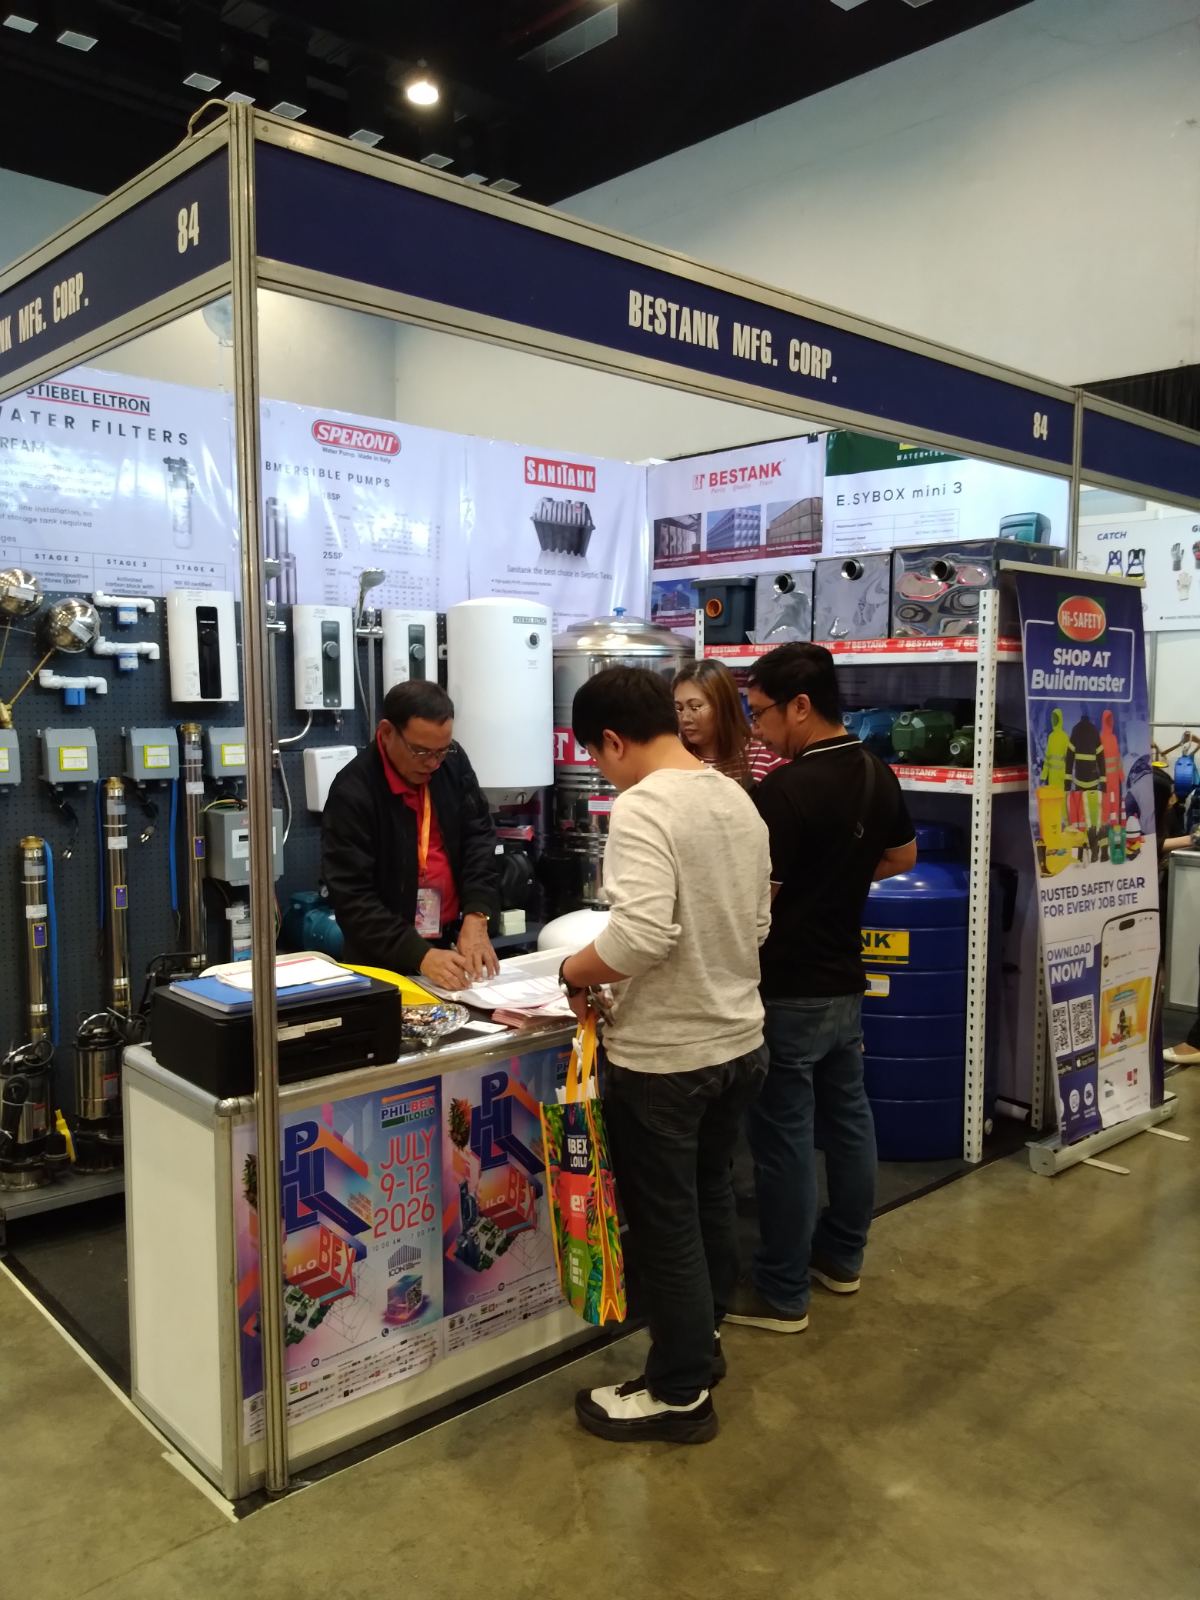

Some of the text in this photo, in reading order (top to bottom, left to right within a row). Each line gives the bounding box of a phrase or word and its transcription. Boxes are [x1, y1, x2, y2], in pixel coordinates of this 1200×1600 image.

[177, 200, 200, 253] 84
[18, 297, 47, 343] MFG.
[53, 271, 89, 323] CORP.
[628, 289, 837, 384] BESTANK MFG. CORP.
[94, 393, 151, 414] ELTRON
[92, 420, 188, 445] FILTERS
[317, 424, 395, 452] SPERONI
[1033, 411, 1049, 441] 84
[347, 472, 391, 488] PUMPS
[709, 461, 782, 488] BESTANK
[836, 482, 963, 507] E.SYBOX mini 3
[1097, 531, 1128, 541] CATCH
[35, 553, 69, 563] STAGE
[107, 559, 138, 568] STAGE
[176, 564, 204, 573] STAGE
[851, 640, 888, 649] BESTANK
[905, 639, 944, 648] BESTANK
[1053, 648, 1112, 668] SHOP AT
[1031, 668, 1126, 693] Buildmaster
[899, 767, 937, 777] BESTANK
[1081, 880, 1114, 897] SAFETY
[1116, 876, 1146, 891] GEAR
[1043, 892, 1138, 919] FOR EVERY JOB SITE
[1051, 960, 1084, 985] NOW
[406, 1107, 436, 1122] ILOILO
[381, 1127, 435, 1170] JULY
[374, 1194, 436, 1240] 2026
